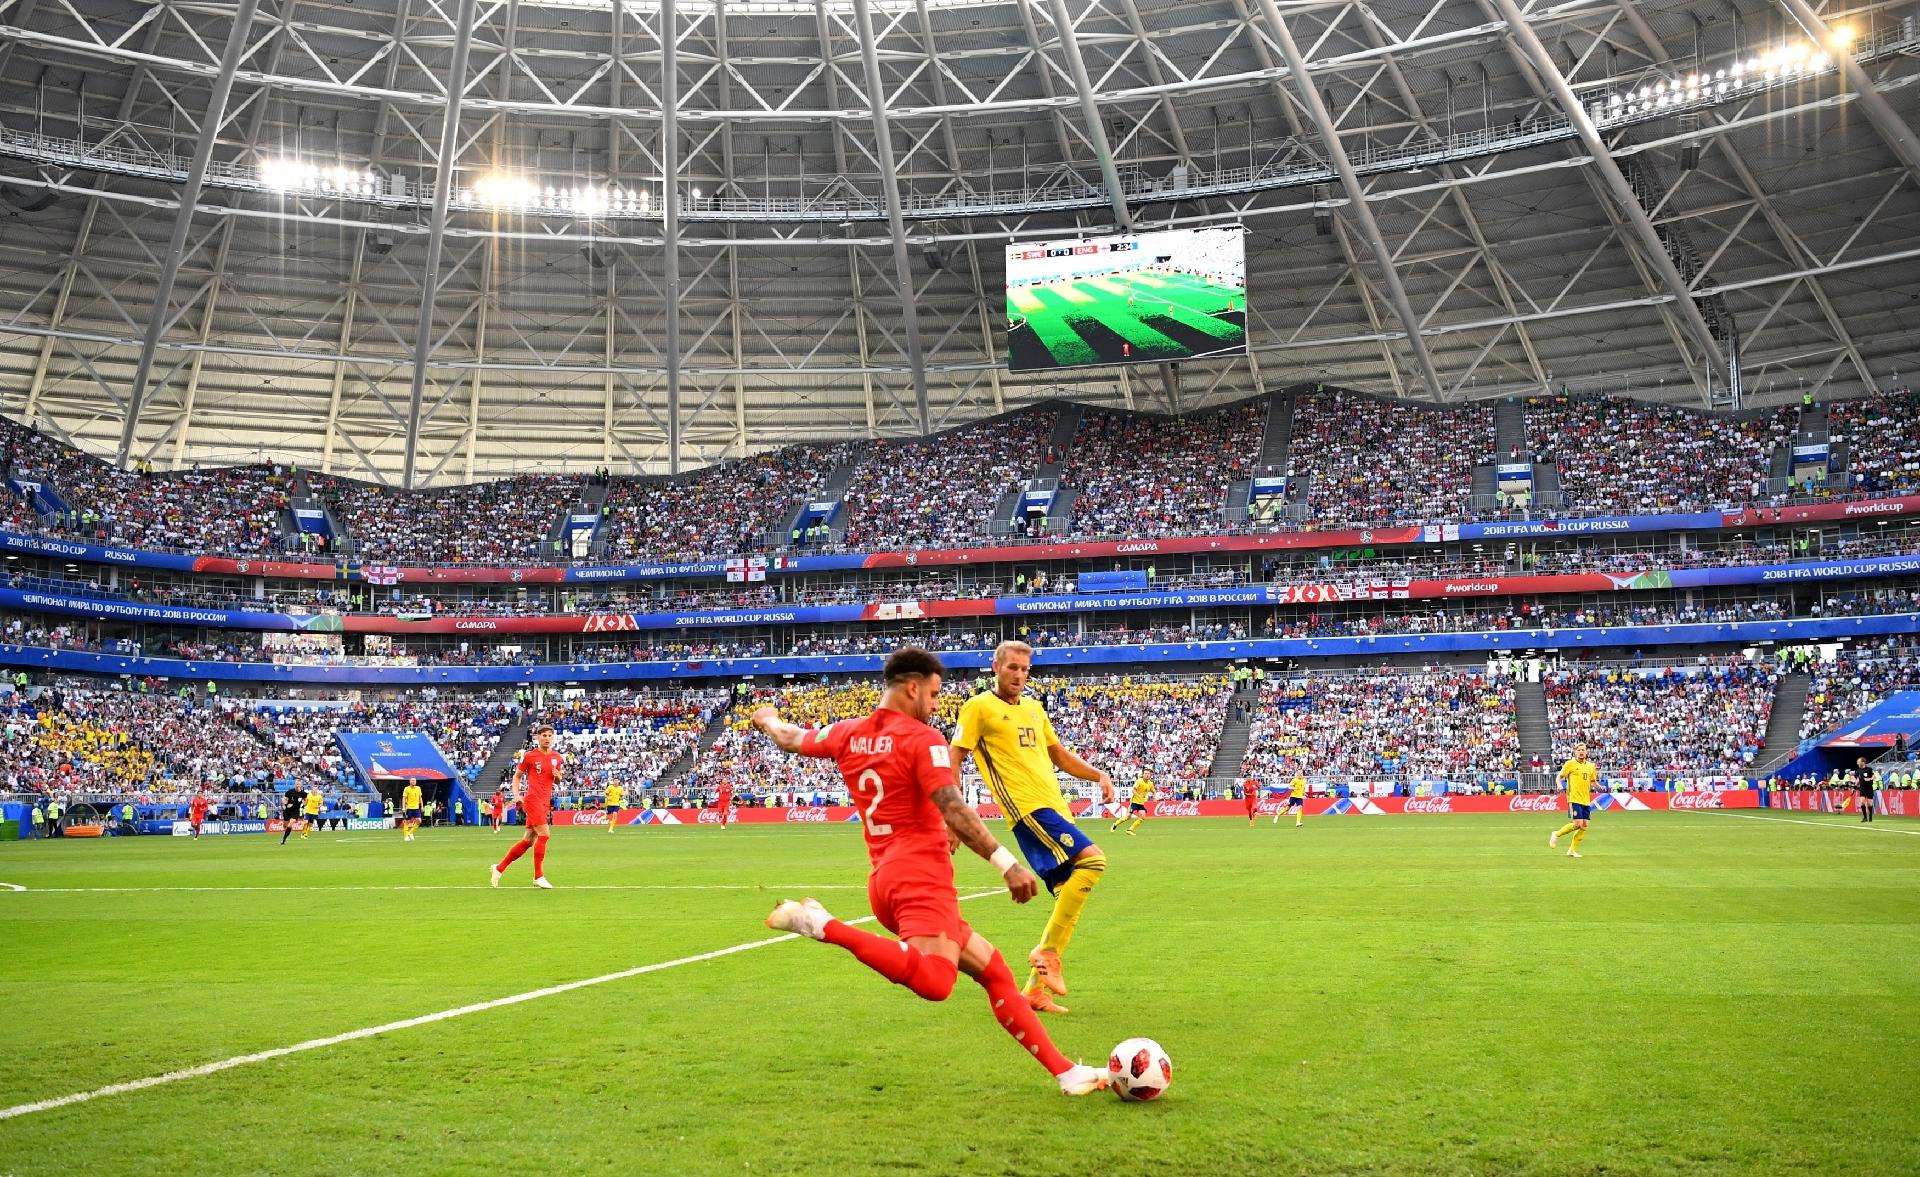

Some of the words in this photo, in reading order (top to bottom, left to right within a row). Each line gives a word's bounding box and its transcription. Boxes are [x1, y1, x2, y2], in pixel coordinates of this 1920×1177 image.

[1026, 251, 1043, 259] SWE
[1076, 246, 1094, 254] ENG
[1845, 503, 1904, 514] #worldcup
[1483, 526, 1505, 535] 2018
[1507, 525, 1529, 534] FIFA
[1567, 522, 1589, 531] CUP
[1590, 520, 1629, 530] RUSSIA
[7, 537, 23, 548] 2018
[69, 546, 87, 555] CUP
[105, 550, 136, 561] RUSSIA
[1116, 543, 1158, 552] САМАРА
[575, 569, 626, 577] ЧЕМПИОНАТ
[640, 567, 664, 576] МИРА
[666, 566, 678, 574] ПО
[679, 563, 717, 574] ФУТБОЛУ
[1763, 570, 1787, 579] 2018
[1788, 568, 1811, 578] FIFA
[1813, 565, 1852, 577] WORLD
[1854, 563, 1877, 573] CUP
[1879, 560, 1919, 572] RUSSIA
[1445, 582, 1498, 592] #worldcup
[23, 594, 67, 607] ЧЕМПИОНАТ
[68, 600, 91, 610] МИРА
[91, 603, 103, 612] ПО
[104, 604, 142, 616] ФУТБОЛУ
[143, 608, 161, 618] FIFA
[162, 610, 181, 619] 2018
[183, 611, 189, 619] В
[190, 612, 226, 622] РОССИИ
[1016, 601, 1072, 611] ЧЕМПИОНАТ
[1074, 599, 1102, 608] МИРА
[1103, 599, 1116, 607] ПО
[1118, 597, 1162, 606] ФУТБОЛУ
[1163, 595, 1183, 605] FIFA
[1187, 595, 1208, 603] 2018
[1209, 594, 1217, 602] В
[1218, 592, 1257, 602] РОССИИ
[455, 621, 496, 629] САМАРА
[675, 617, 695, 625] 2018
[695, 616, 712, 624] FIFA
[713, 614, 743, 623] WORLD
[744, 614, 761, 622] CUP
[763, 612, 794, 621] RUSSIA
[1016, 726, 1036, 748] 20
[849, 735, 894, 755] WALER
[536, 764, 542, 774] 5
[858, 768, 893, 837] 2
[1154, 801, 1200, 816] Coca-Cola
[1404, 797, 1451, 813] Coca-Cola
[1509, 795, 1559, 811] Coca-Cola
[787, 807, 828, 822] Coca-Cola
[230, 823, 244, 832] 万达
[244, 822, 266, 832] WANDA
[347, 819, 384, 830] Hisense
